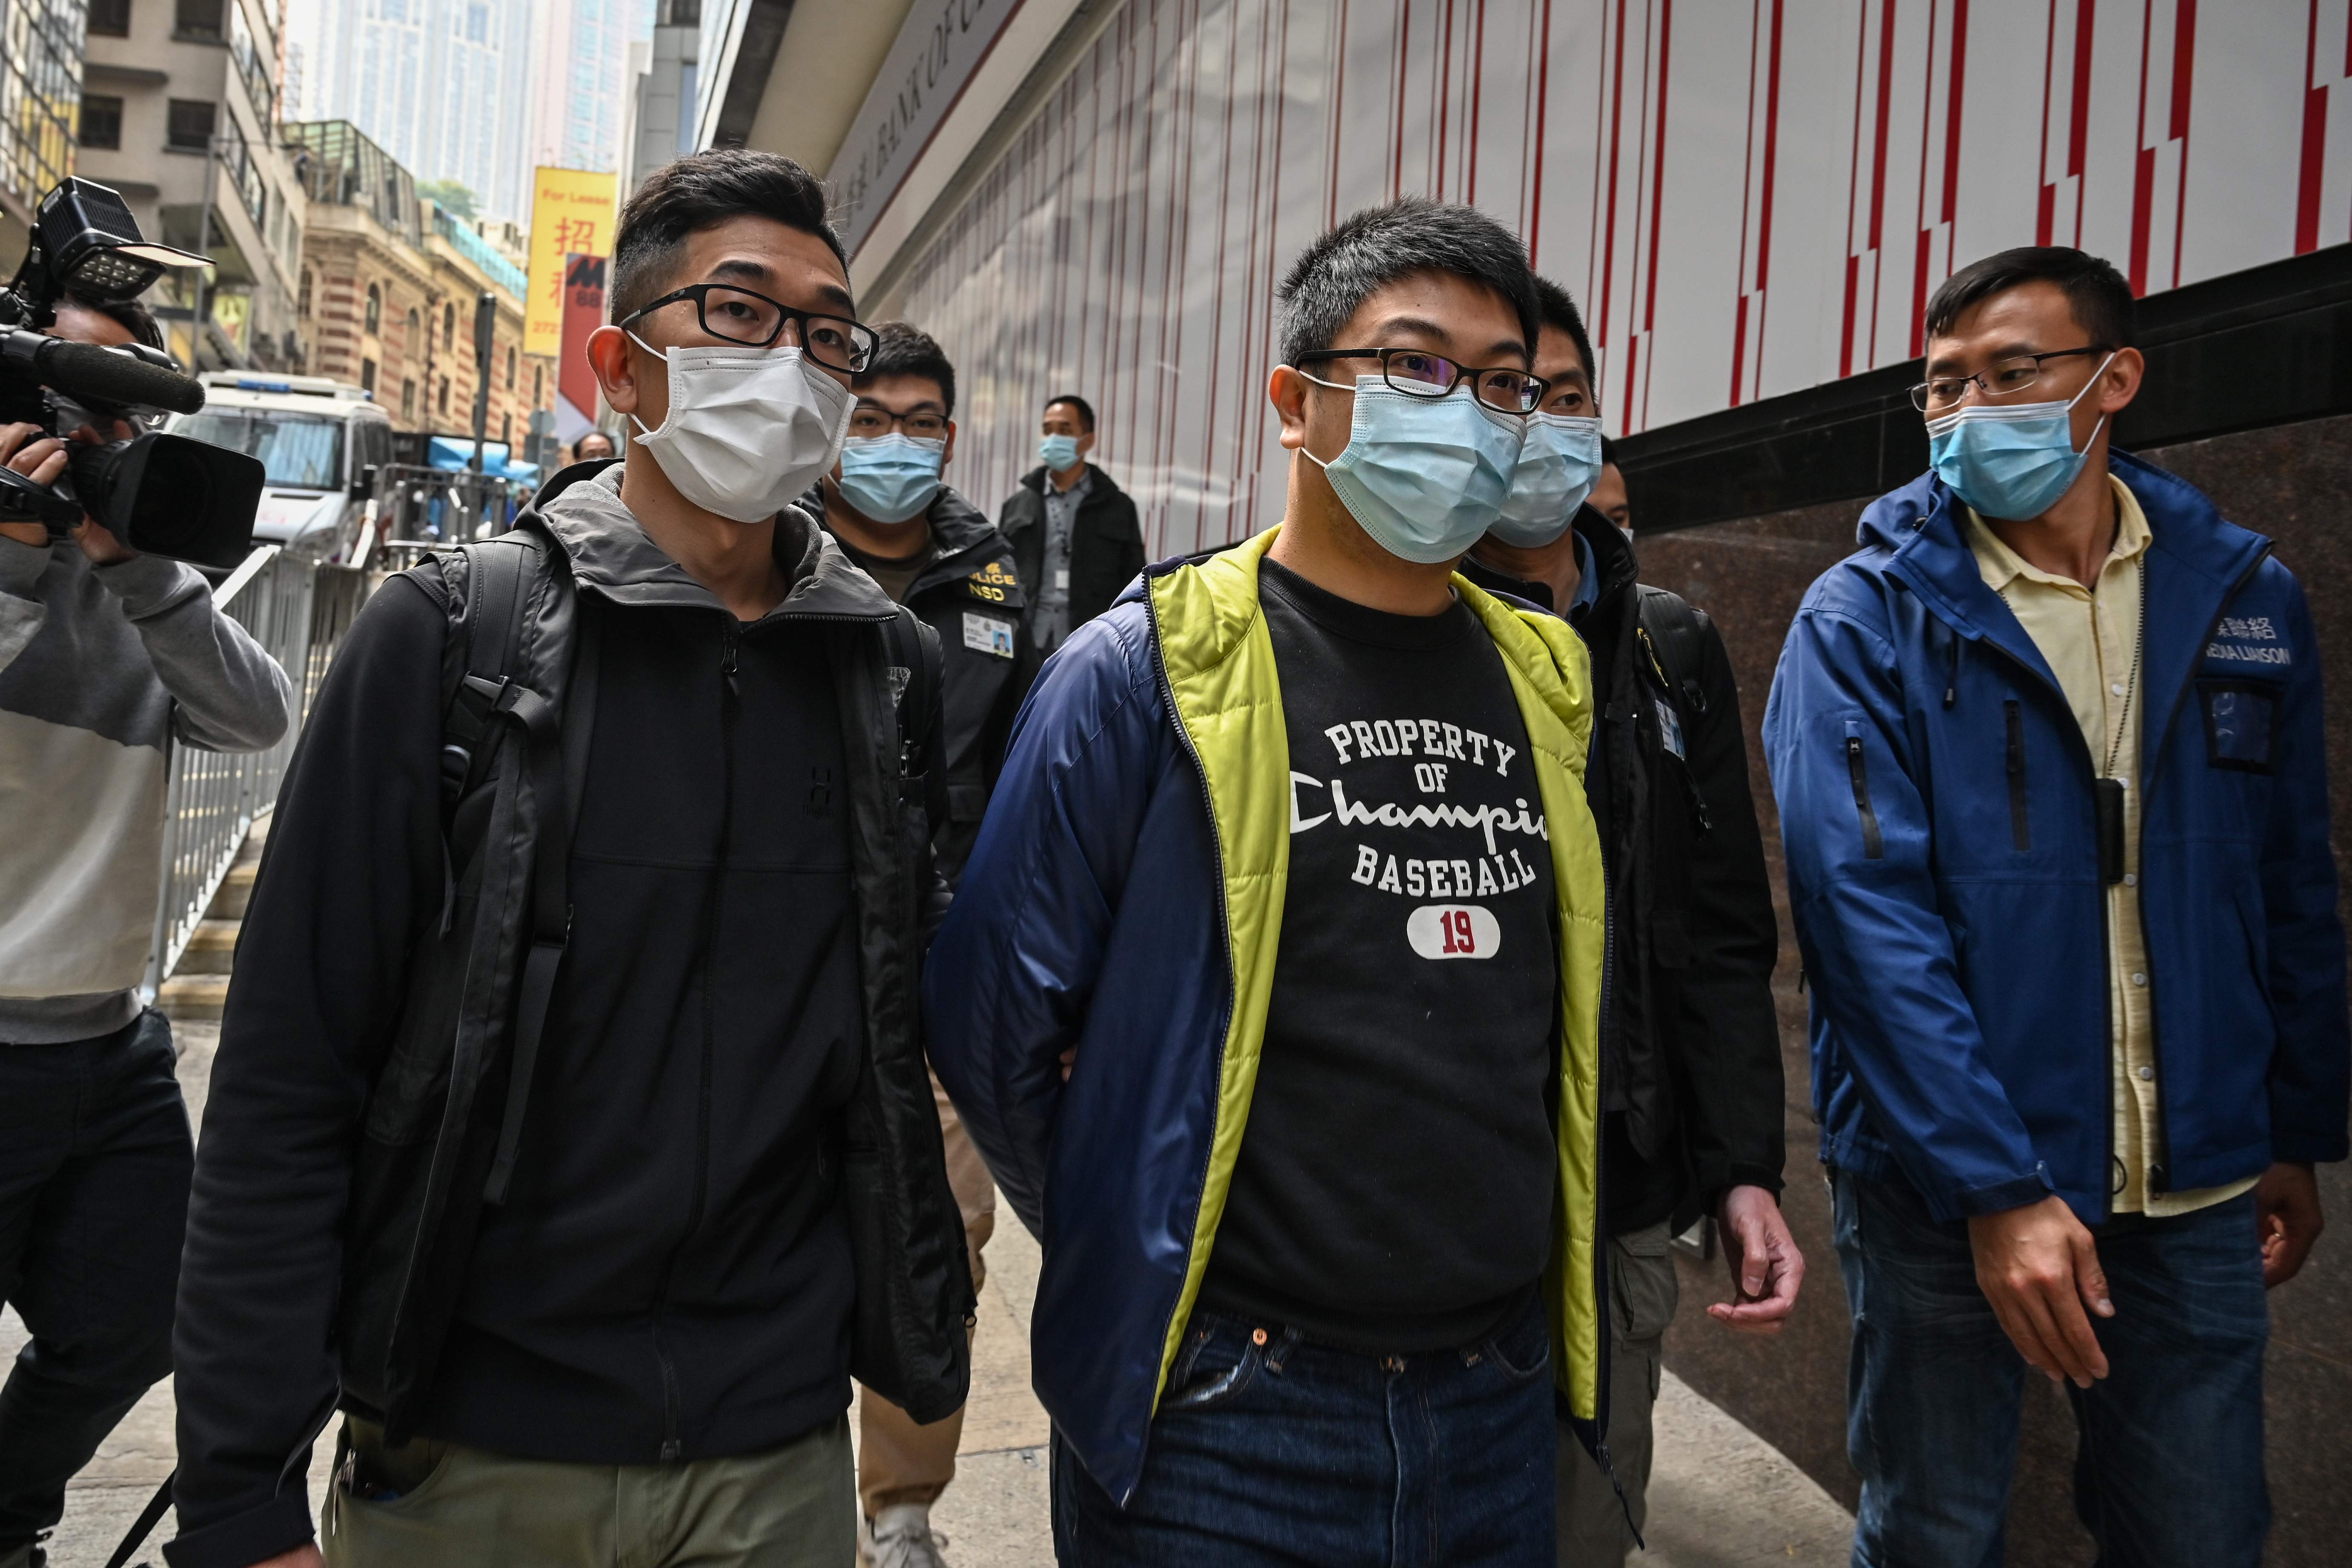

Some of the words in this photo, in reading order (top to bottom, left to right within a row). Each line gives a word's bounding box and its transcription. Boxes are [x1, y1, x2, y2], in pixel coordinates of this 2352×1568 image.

[542, 188, 564, 201] For
[570, 192, 611, 206] Lease
[968, 583, 1005, 602] NSD
[1325, 719, 1515, 777] PROPERTY
[1414, 763, 1447, 793] OF
[1351, 844, 1536, 897] BASEBALL
[1440, 910, 1475, 954] 19
